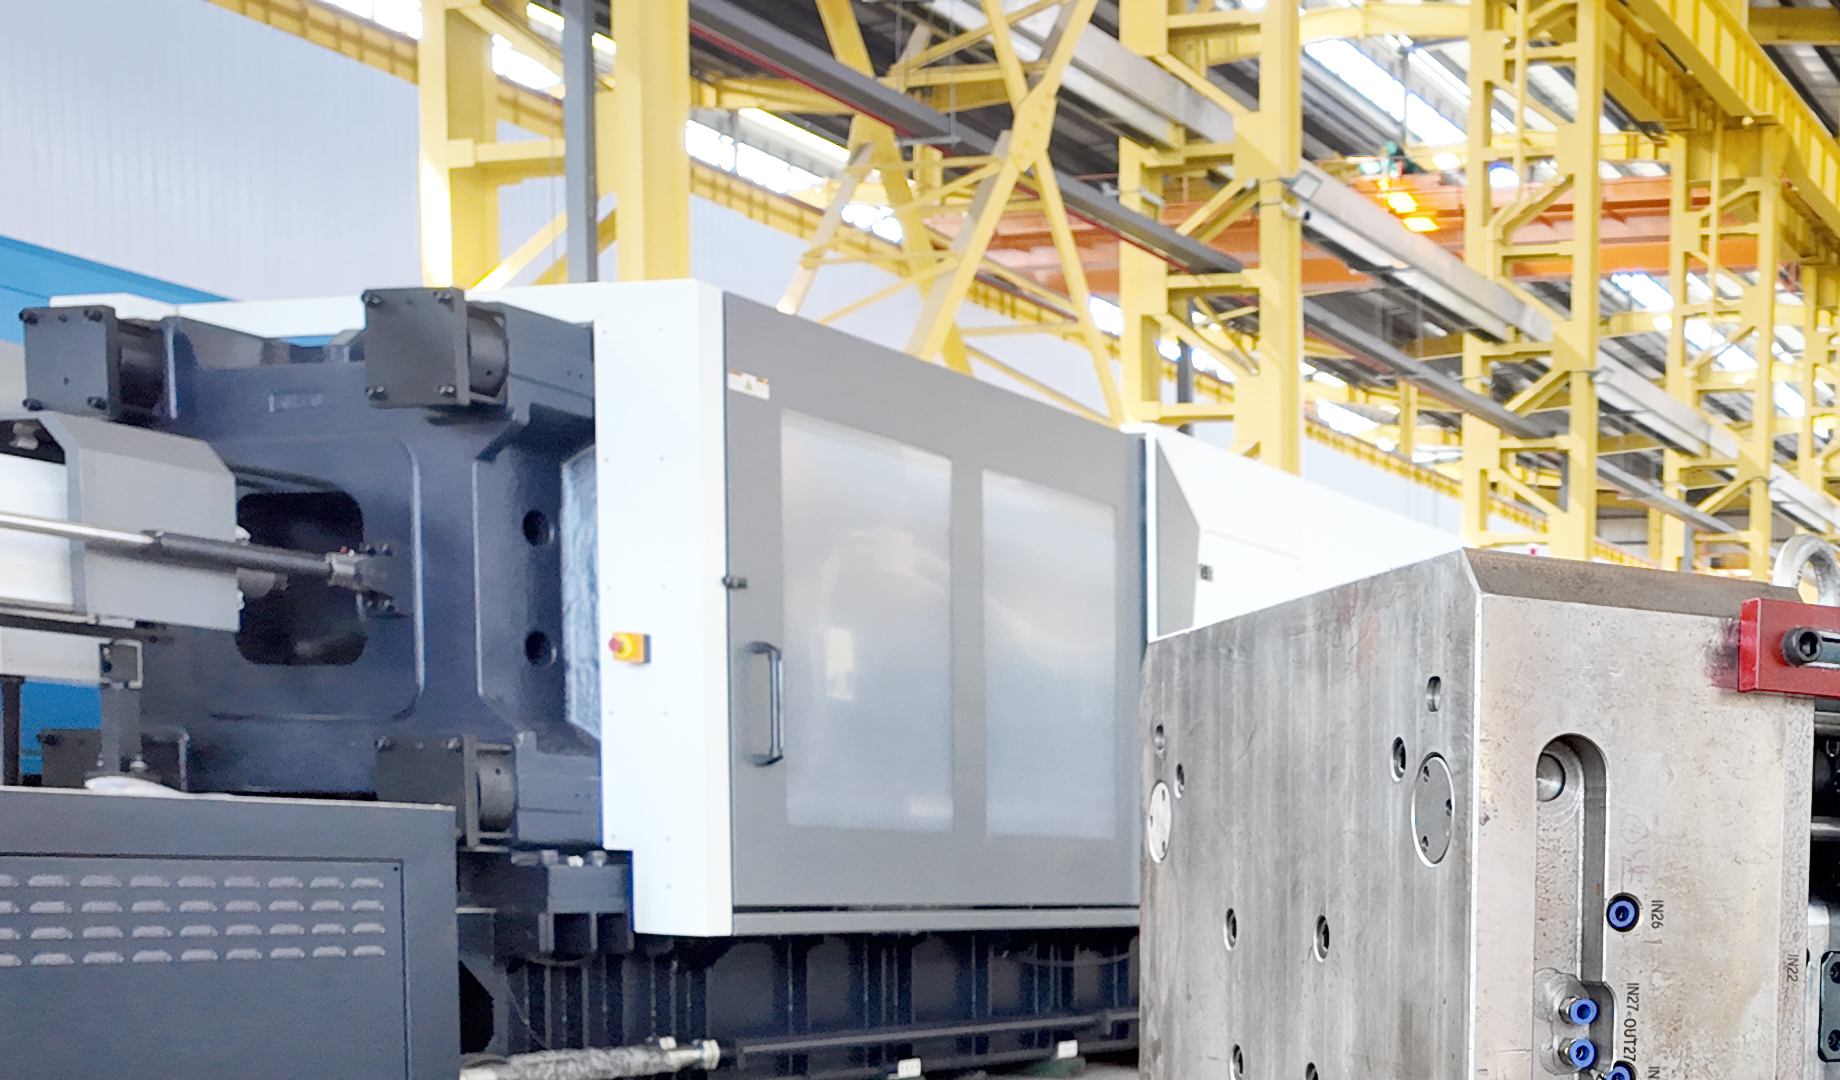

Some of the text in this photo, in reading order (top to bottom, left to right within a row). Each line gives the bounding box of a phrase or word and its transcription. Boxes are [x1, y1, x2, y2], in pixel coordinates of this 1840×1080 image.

[1651, 899, 1664, 929] IN26
[1786, 953, 1799, 983] IN22
[1623, 982, 1639, 1062] IN27 OUT27
